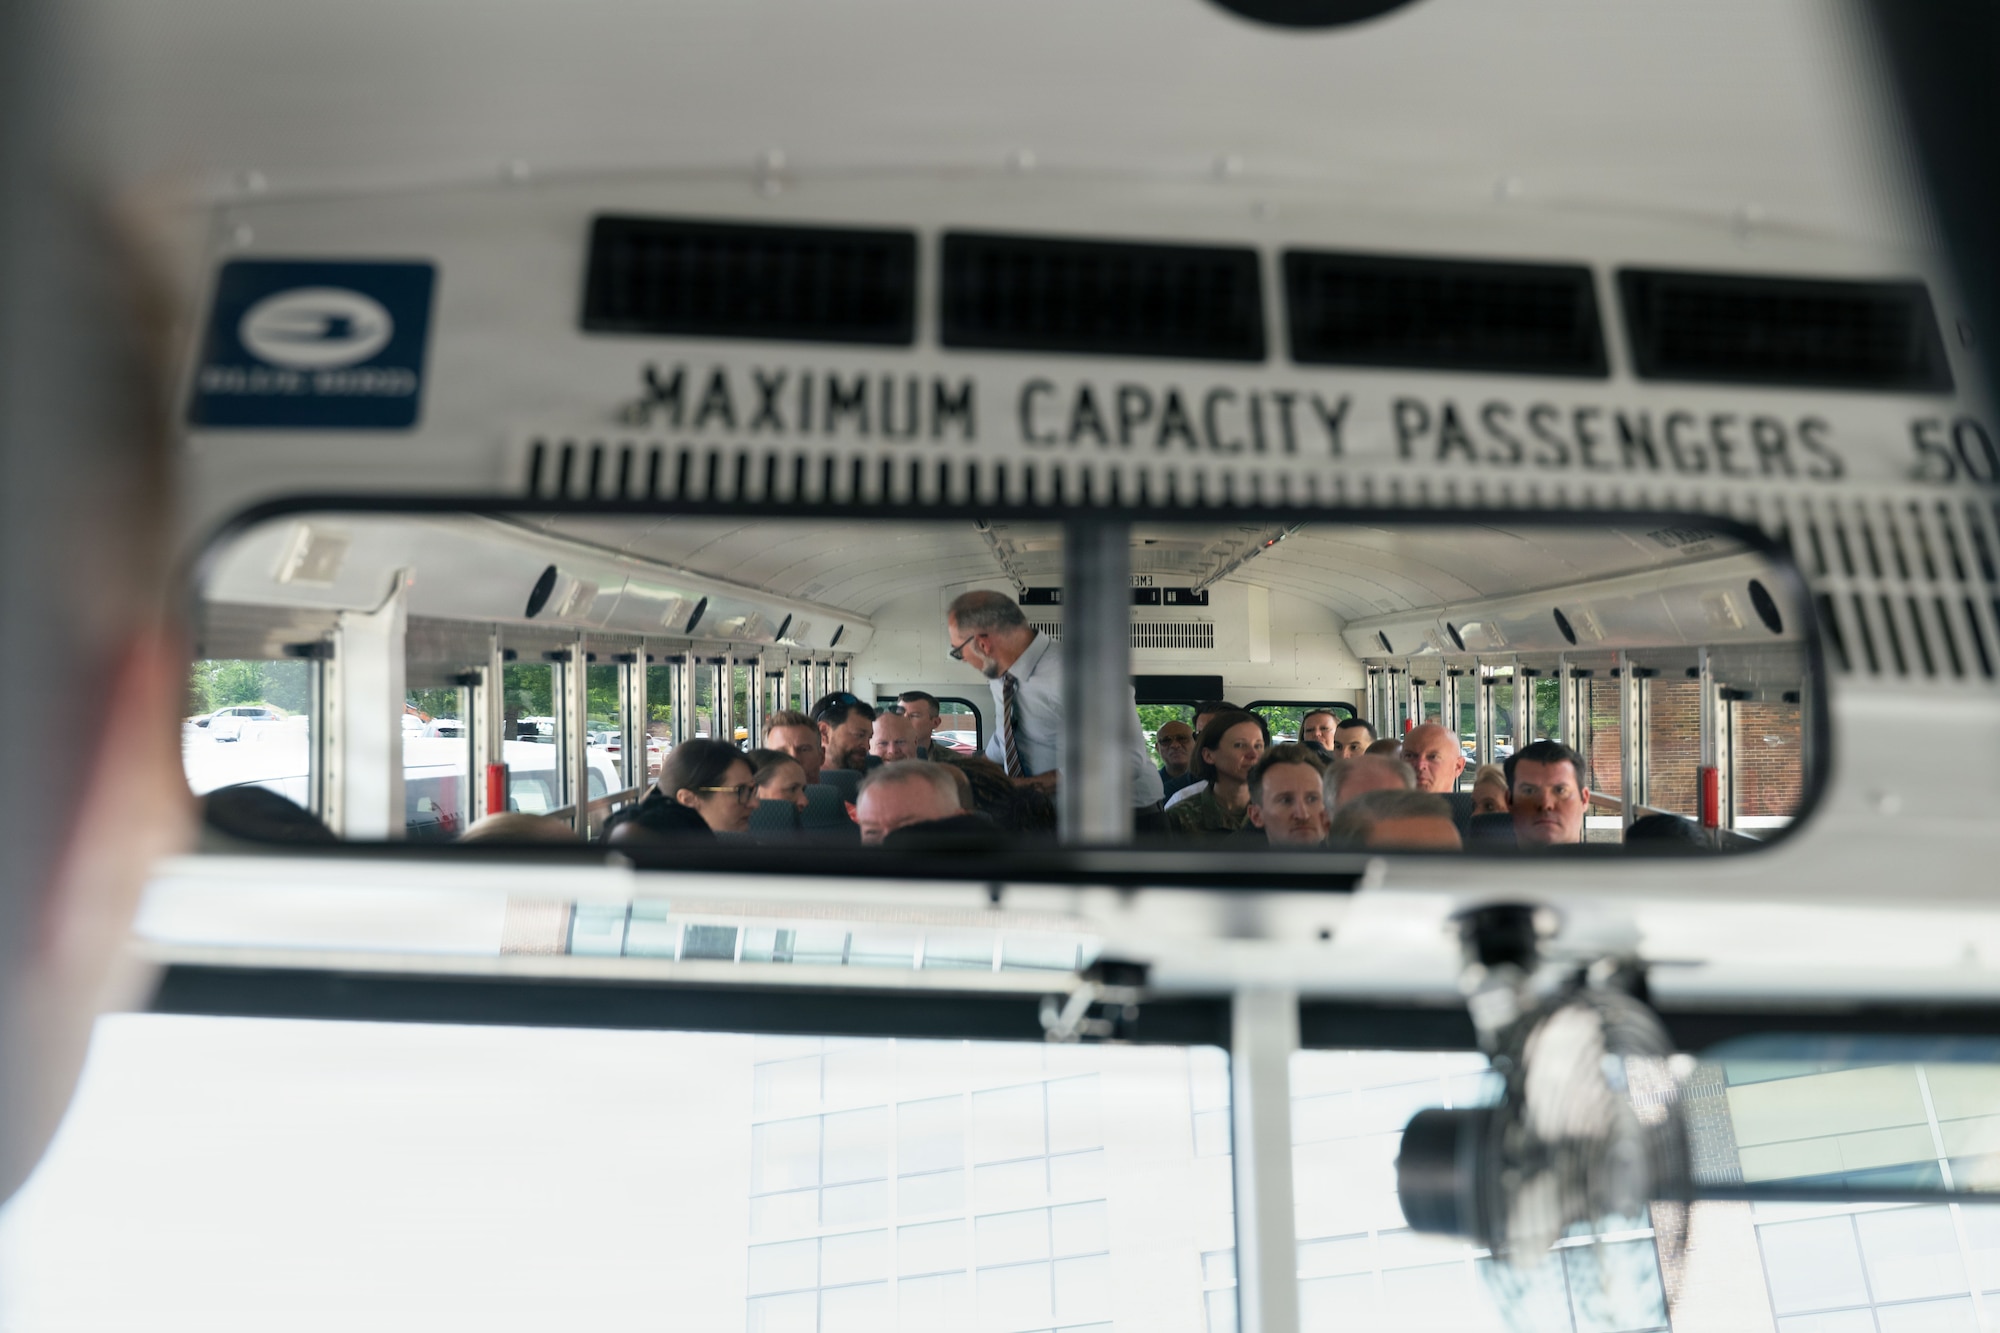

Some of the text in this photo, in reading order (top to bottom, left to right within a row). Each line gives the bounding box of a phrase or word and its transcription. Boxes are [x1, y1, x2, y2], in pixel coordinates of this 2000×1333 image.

[640, 363, 2000, 485] MAXIMUM CAPACITY PASSENGERS 50
